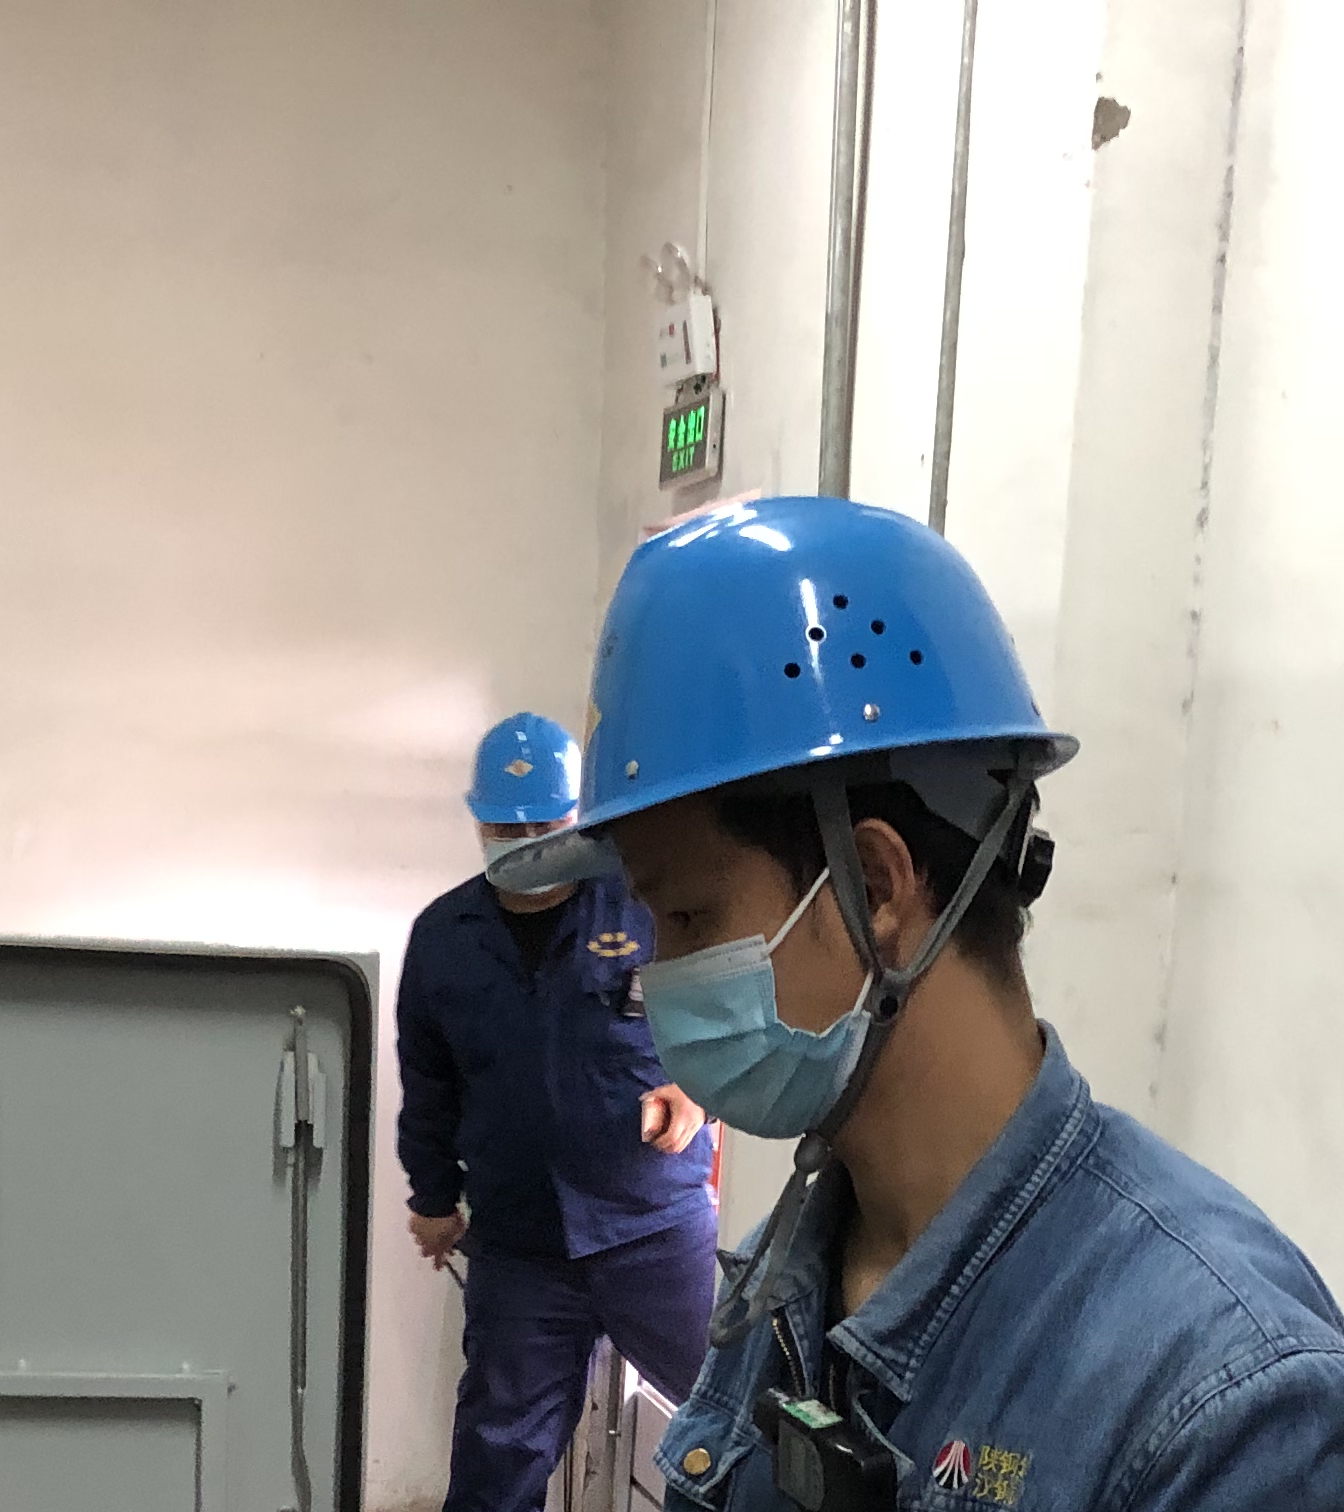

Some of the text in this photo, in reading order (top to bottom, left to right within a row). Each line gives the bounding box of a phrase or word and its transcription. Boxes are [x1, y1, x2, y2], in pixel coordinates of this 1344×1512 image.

[667, 405, 705, 452] 安全出口
[672, 445, 695, 473] EXIT
